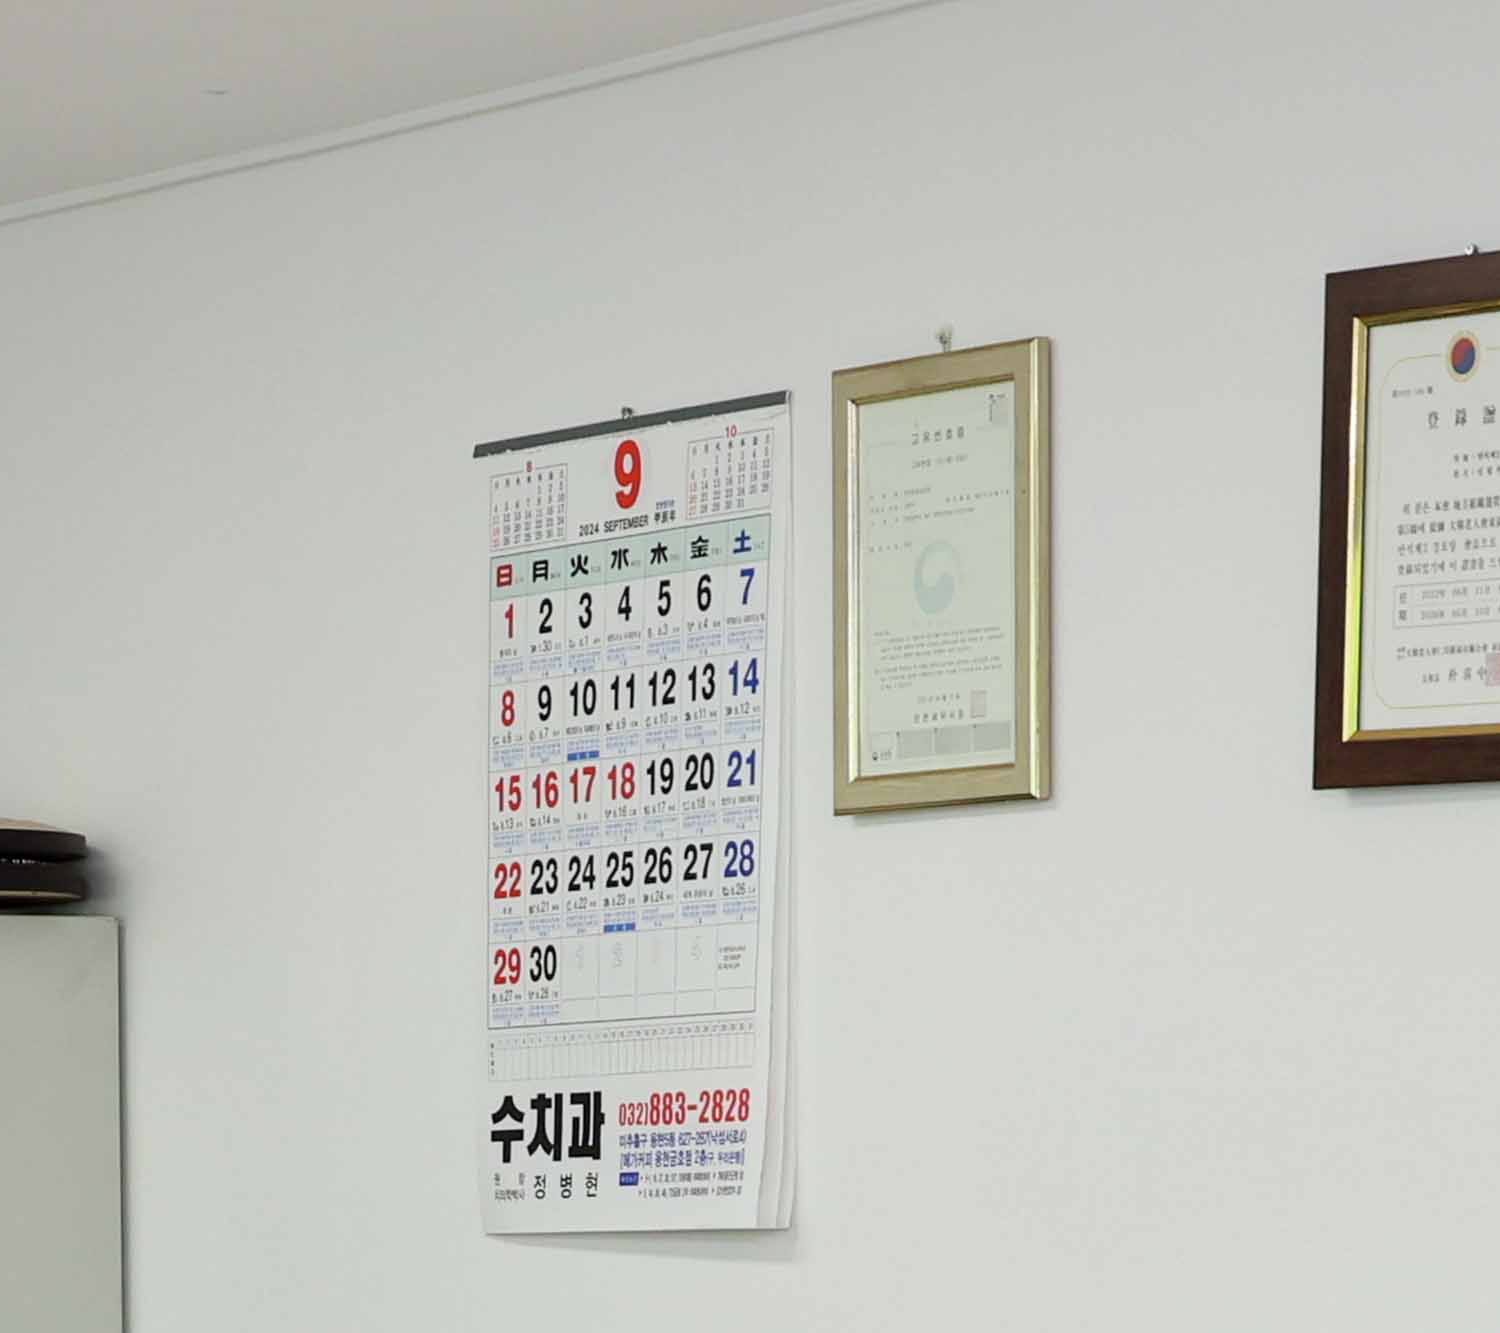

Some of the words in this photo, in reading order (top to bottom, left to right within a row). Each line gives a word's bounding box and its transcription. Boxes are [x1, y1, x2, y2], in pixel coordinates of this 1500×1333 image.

[726, 427, 737, 438] 10
[614, 440, 641, 509] 9
[579, 524, 600, 537] 2024
[603, 515, 649, 533] SEPTEMBER
[496, 564, 512, 587] 日
[533, 560, 549, 583] 月
[571, 554, 589, 577] 火
[611, 548, 629, 570] 水
[650, 542, 668, 565] 木
[690, 536, 709, 559] 金
[733, 529, 752, 554] 土
[505, 604, 513, 638] 1
[539, 598, 553, 634] 2
[579, 592, 592, 629] 3
[618, 586, 632, 621] 4
[657, 580, 671, 616] 5
[697, 574, 711, 611] 6
[740, 568, 754, 605] 7
[501, 690, 515, 727] 8
[538, 685, 552, 721] 9
[570, 679, 596, 717] 10
[611, 673, 635, 711] 11
[648, 668, 676, 706] 12
[688, 663, 715, 701] 13
[729, 658, 759, 696] 14
[495, 775, 521, 812] 15
[532, 771, 558, 808] 16
[570, 766, 596, 804] 17
[608, 762, 635, 800] 18
[647, 758, 674, 795] 19
[685, 752, 714, 791] 20
[727, 749, 755, 787] 21
[494, 862, 521, 899] 22
[530, 858, 558, 895] 23
[568, 855, 596, 892] 24
[606, 851, 634, 888] 25
[644, 846, 672, 885] 26
[683, 843, 713, 881] 27
[724, 839, 754, 878] 28
[494, 948, 521, 985] 29
[530, 945, 557, 982] 30
[491, 1091, 605, 1163] 수치과
[619, 1088, 751, 1126] 032)883-2828
